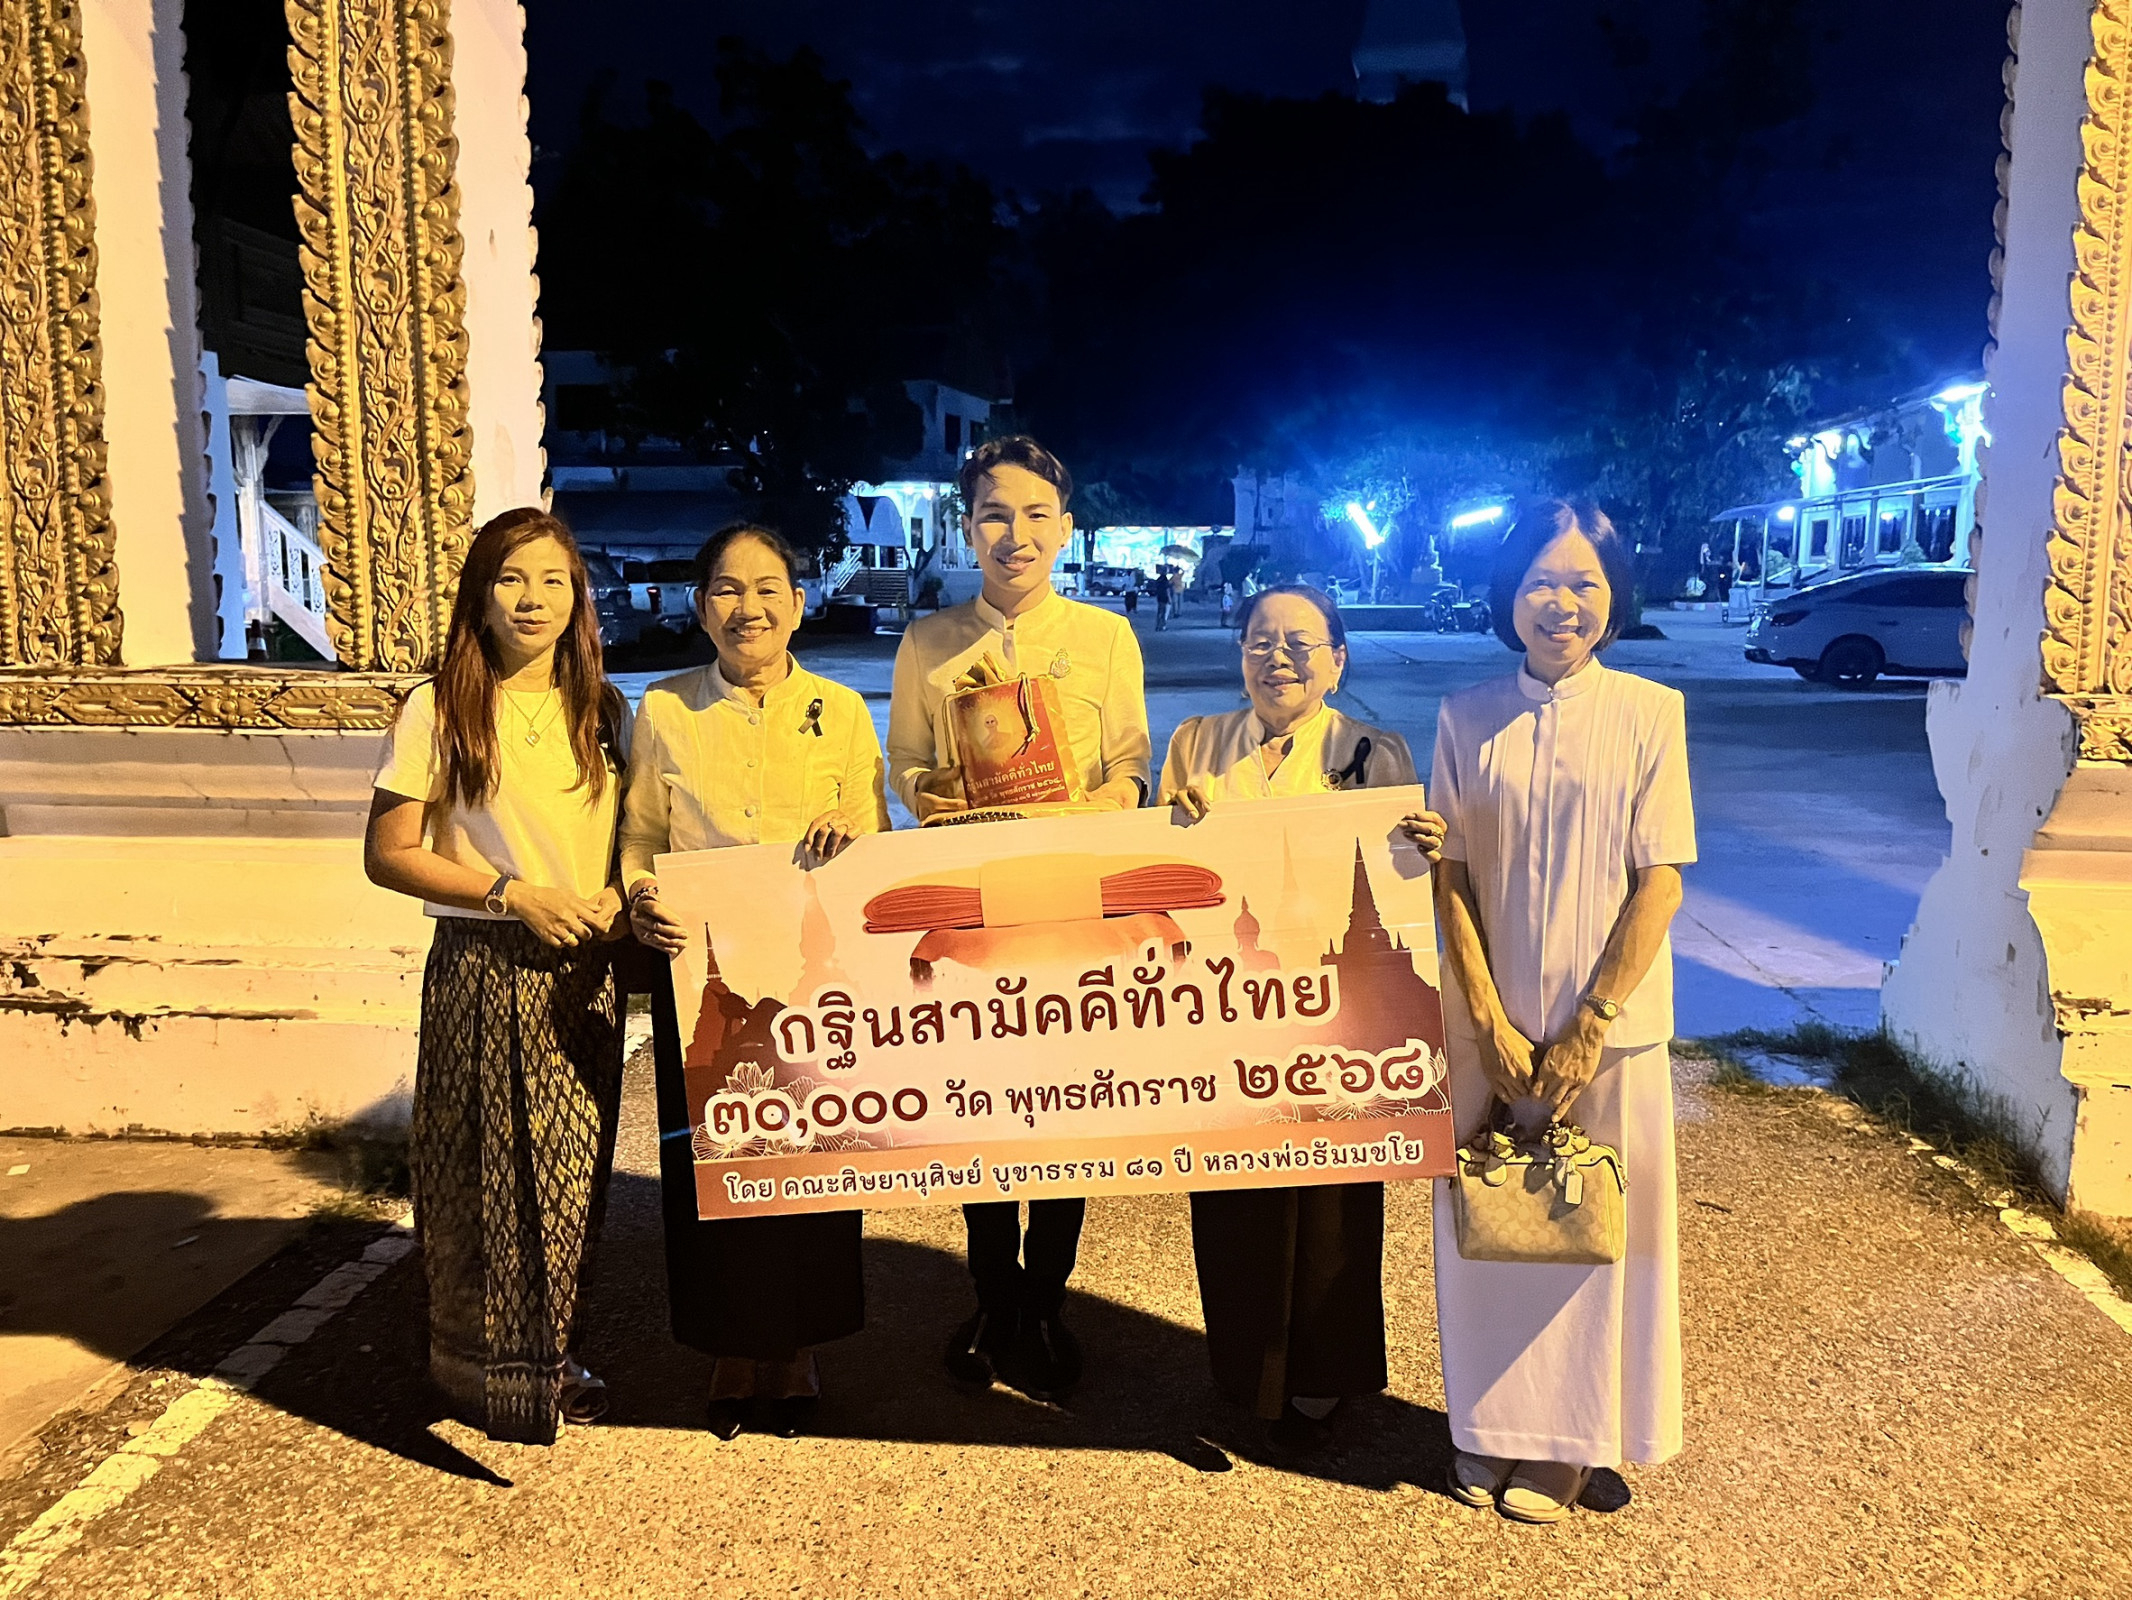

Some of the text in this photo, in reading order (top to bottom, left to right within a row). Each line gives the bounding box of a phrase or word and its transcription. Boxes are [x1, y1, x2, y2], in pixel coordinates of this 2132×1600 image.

[779, 946, 1331, 1070] กฐินสามัคคีทั่วไทย
[713, 1047, 1424, 1138] ๓๐,๐๐๐ วัด พุทธศักราช ๒๕๖๘
[726, 1135, 1420, 1200] โดย คณะศิษยานุศิษย์ บูชาธรรม ๘๑ ปี หลวงพ่อธัมมชโย
